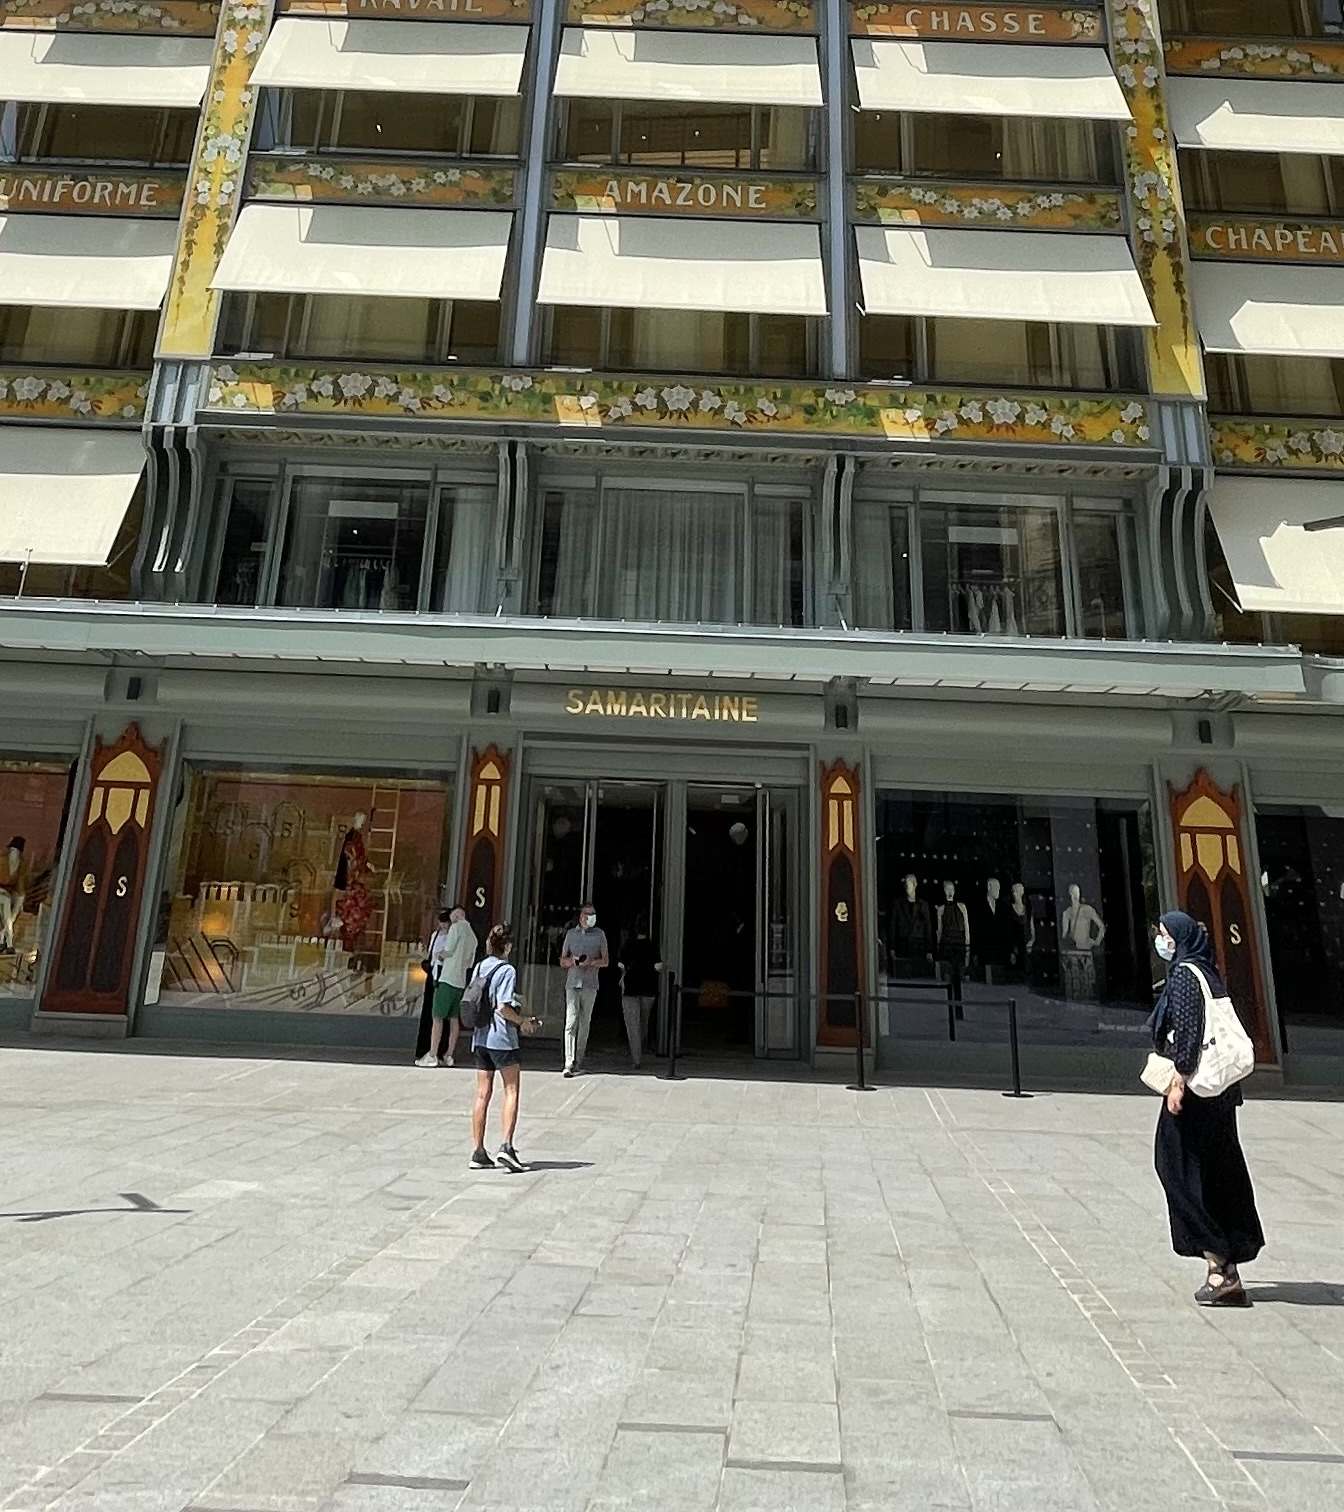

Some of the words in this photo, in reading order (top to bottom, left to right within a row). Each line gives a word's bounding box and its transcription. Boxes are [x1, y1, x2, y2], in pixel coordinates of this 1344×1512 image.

[906, 8, 1046, 35] CHASSE
[602, 180, 767, 209] AMAZONE
[564, 688, 759, 722] SAMARITAINE
